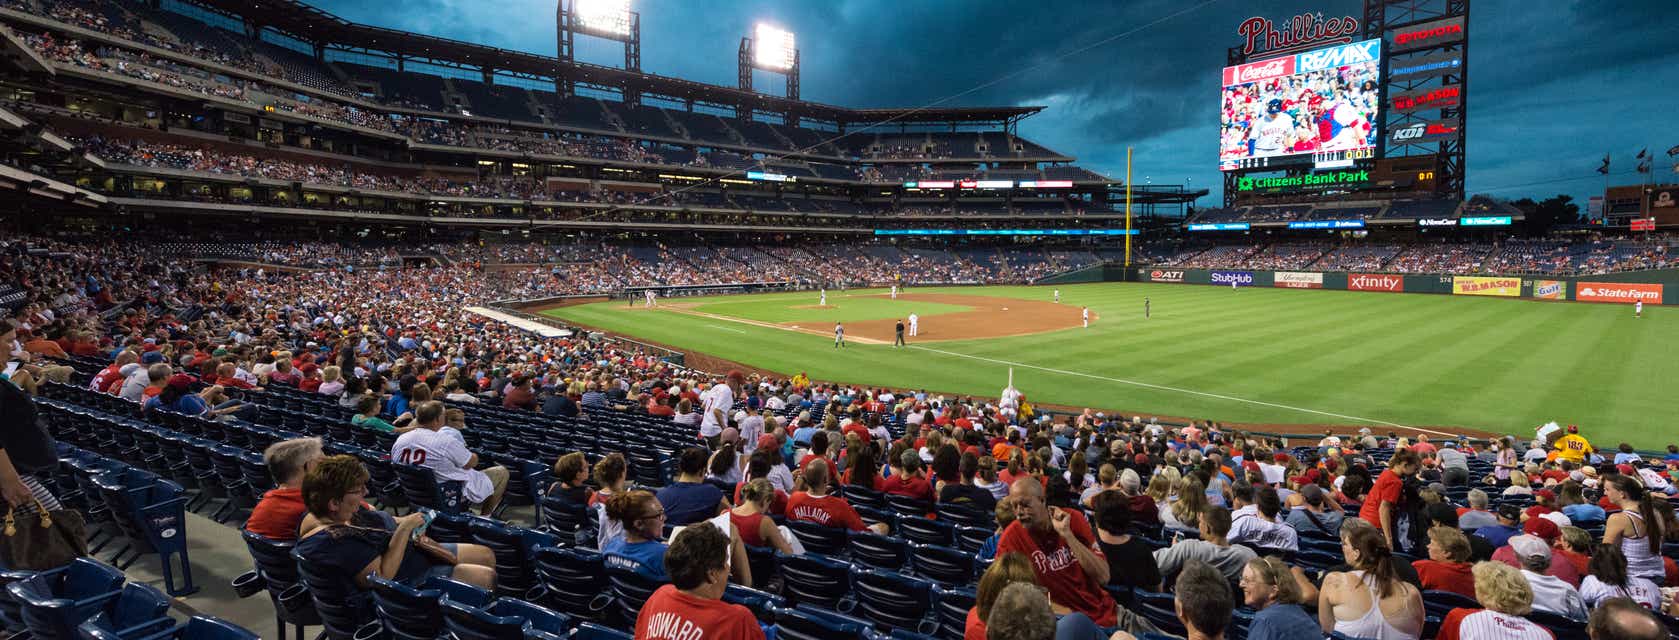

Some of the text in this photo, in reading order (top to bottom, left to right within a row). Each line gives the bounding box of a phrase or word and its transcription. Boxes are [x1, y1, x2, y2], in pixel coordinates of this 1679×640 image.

[1238, 13, 1357, 55] Phillies
[1412, 24, 1462, 41] TOYOTA
[1300, 42, 1372, 72] RE/MAX
[1255, 176, 1303, 188] Citizens
[1304, 173, 1336, 185] Bank
[1338, 169, 1369, 182] Park
[1211, 272, 1252, 283] StubHub
[1351, 275, 1399, 290] xfinity
[1538, 284, 1560, 295] Gulf
[1567, 440, 1583, 451] 183
[793, 507, 830, 522] HALLADAY
[648, 615, 704, 640] HOWARD
